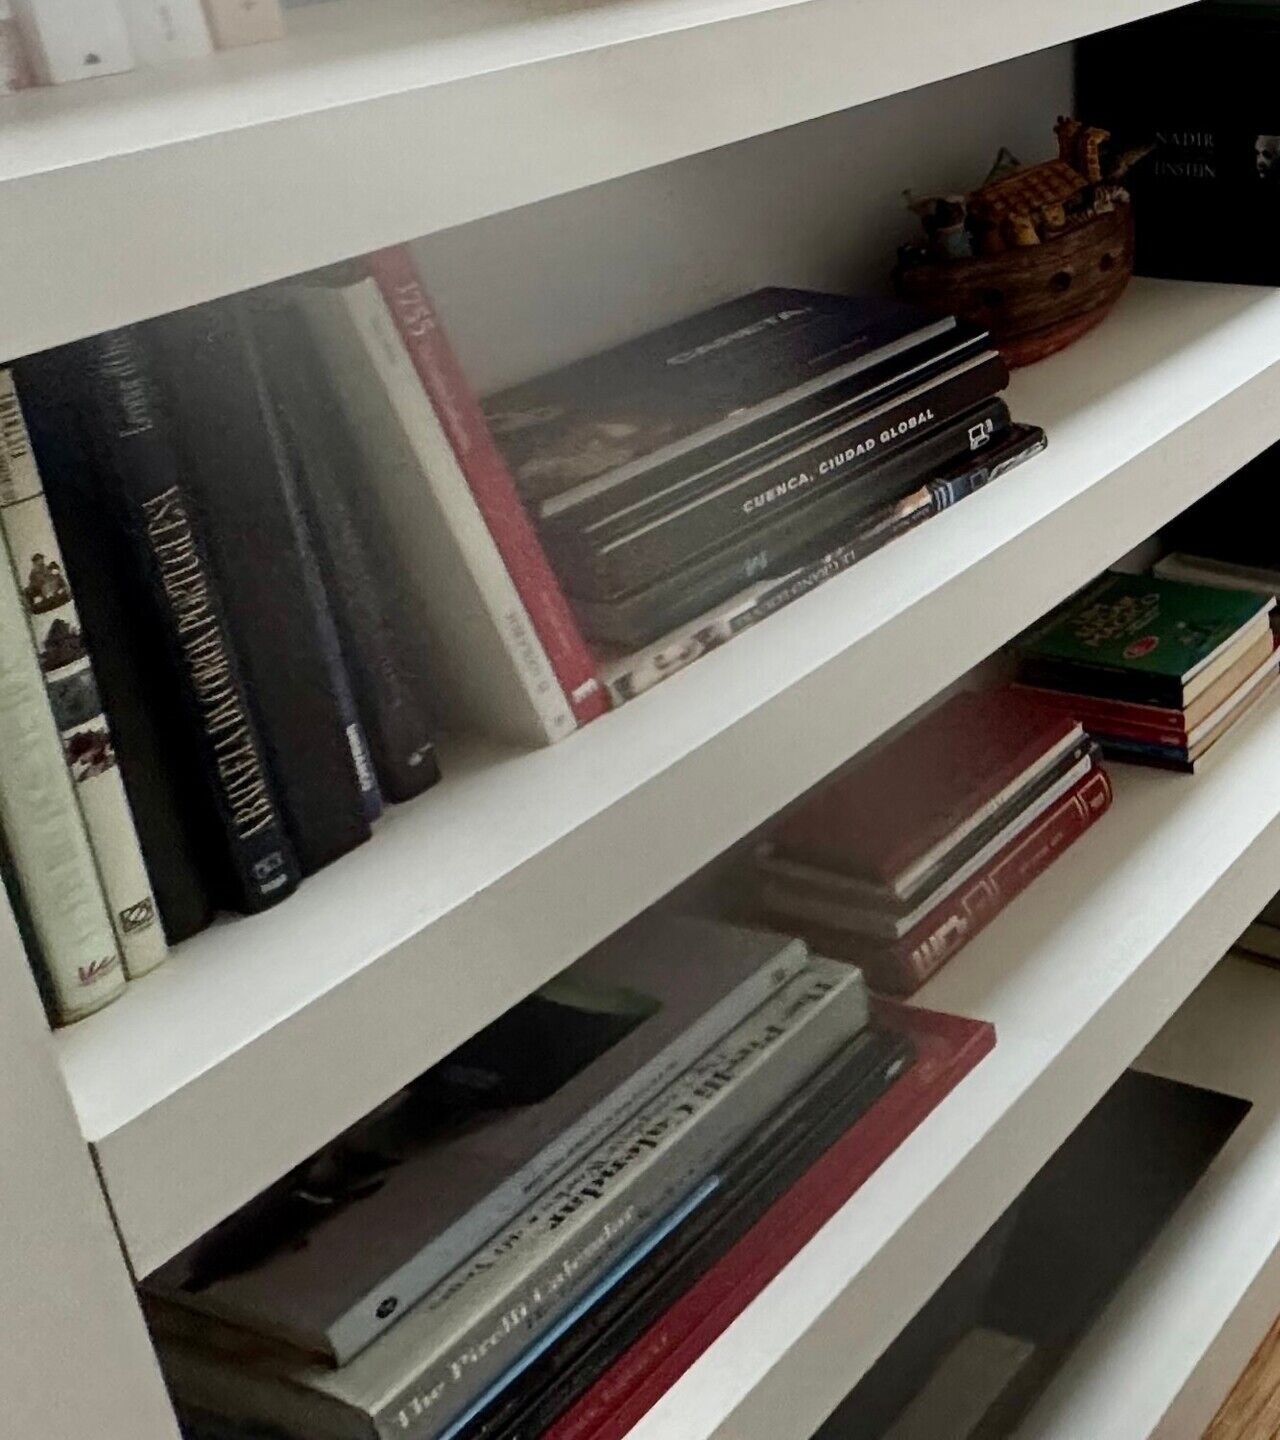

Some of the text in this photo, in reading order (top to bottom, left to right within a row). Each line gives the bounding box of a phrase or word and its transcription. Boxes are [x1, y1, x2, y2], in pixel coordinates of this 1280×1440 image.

[1155, 131, 1215, 148] NADIR
[740, 406, 935, 515] CUENCA, CIUDAD GLOBAL
[546, 1102, 696, 1231] Calendar
[451, 1302, 529, 1383] Pirelli
